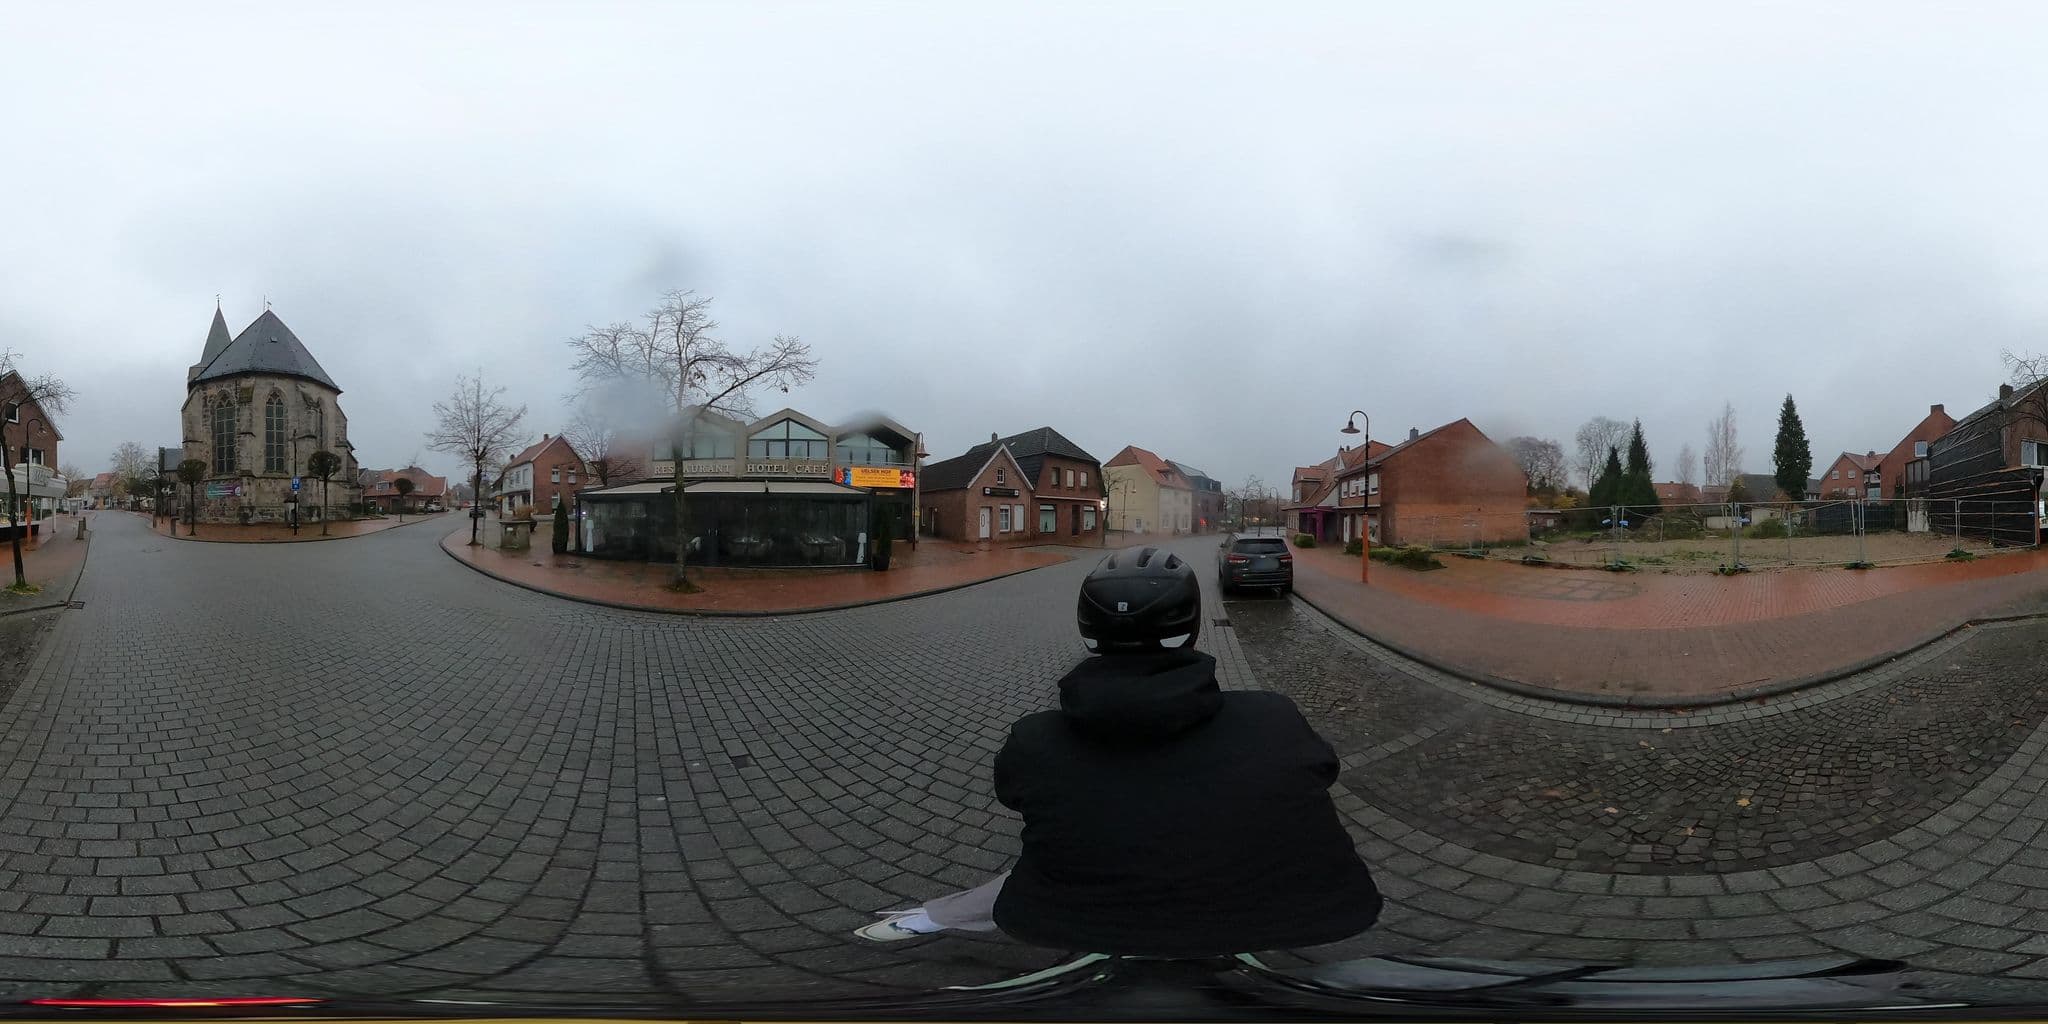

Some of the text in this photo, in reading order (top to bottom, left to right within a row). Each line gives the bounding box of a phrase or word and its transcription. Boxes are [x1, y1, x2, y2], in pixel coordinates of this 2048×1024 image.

[654, 463, 730, 474] RESAURANT
[747, 462, 829, 473] HOTEL CAFÉ
